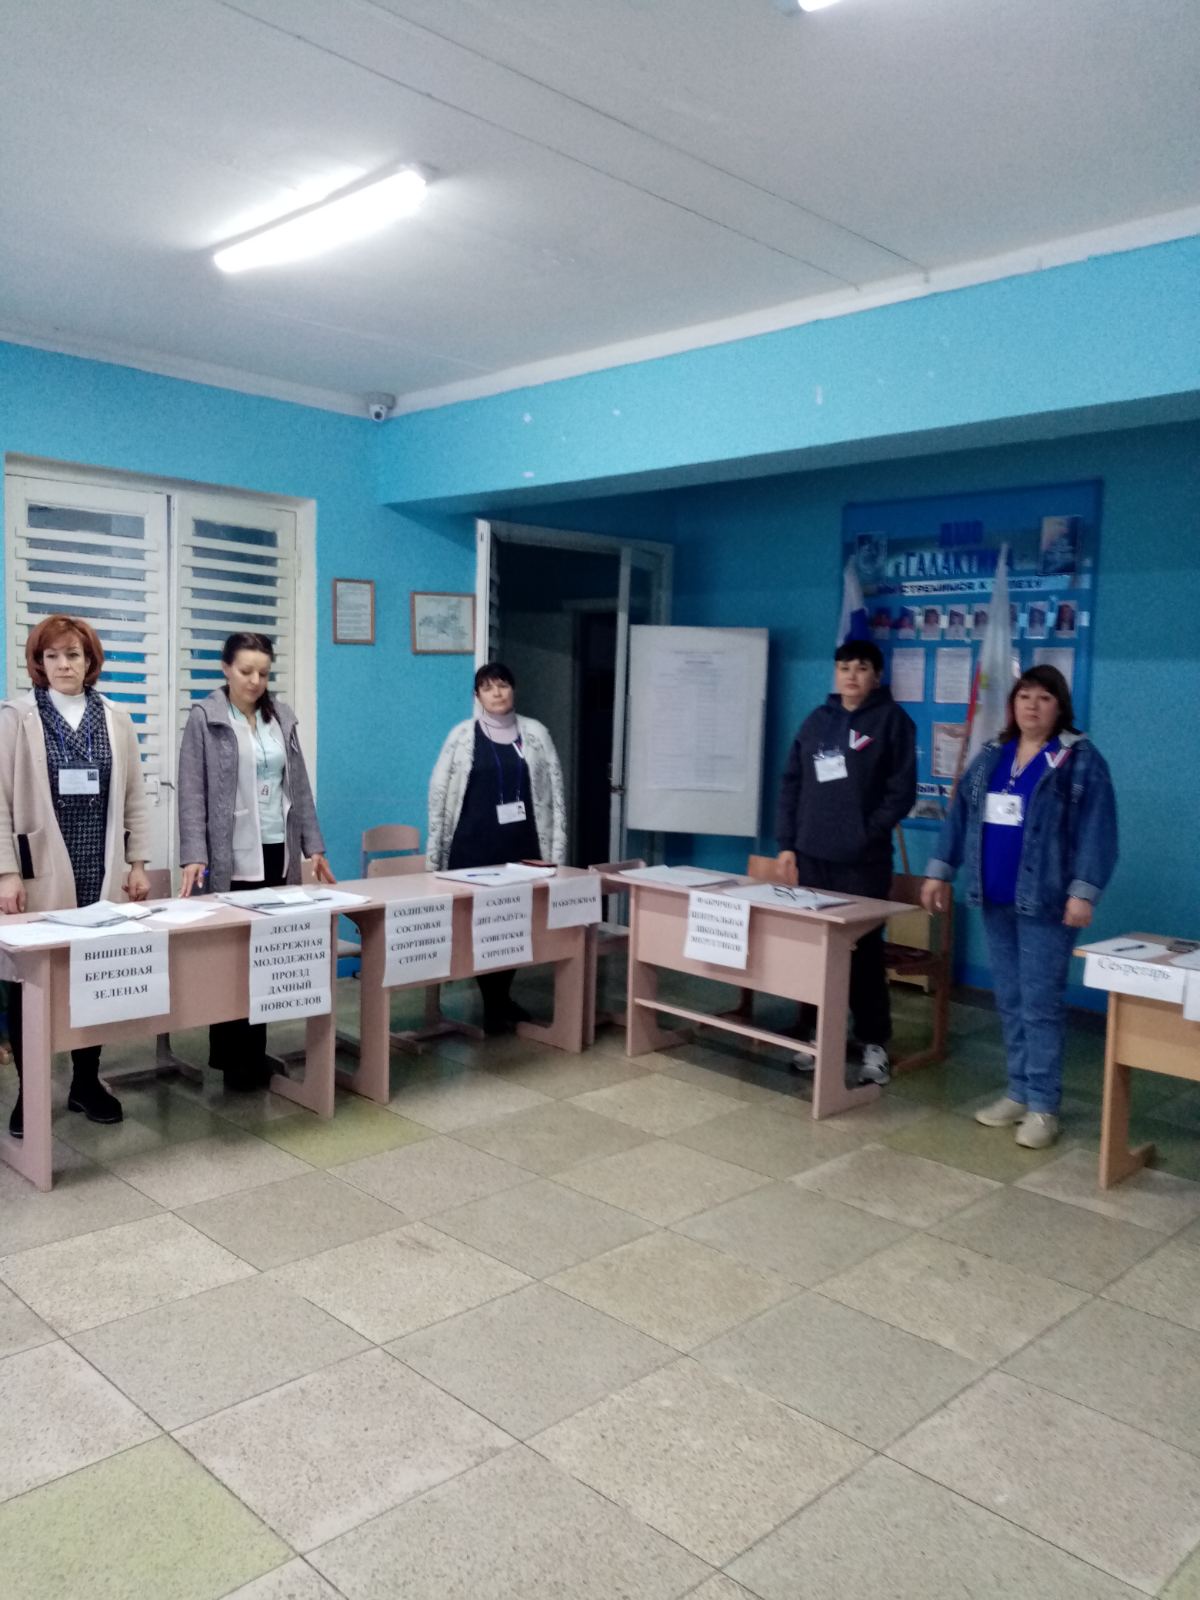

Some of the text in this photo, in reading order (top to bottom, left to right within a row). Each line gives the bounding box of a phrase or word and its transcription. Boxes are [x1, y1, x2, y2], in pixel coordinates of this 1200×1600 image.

[486, 895, 521, 908] САДОВАЯ
[393, 903, 445, 918] СОЛНЕЧНАЯ
[270, 922, 311, 935] ЛЕСНАЯ
[396, 920, 441, 934] СОСНОВАЯ
[391, 935, 446, 952] СПОРТИВНАЯ
[481, 931, 525, 944] СОВЕТСКАЯ
[84, 944, 153, 961] ВИШНЕВАЯ
[255, 938, 323, 954] НАБЕРЕЖНАЯ
[481, 945, 525, 960] СИРЕНЕВАЯ
[253, 951, 326, 968] МОЛОДЕЖНАЯ
[85, 965, 153, 982] БЕРЕЗОВАЯ
[271, 967, 310, 981] ПРОЕЗД
[93, 984, 148, 1000] ЗЕЛЕНАЯ
[268, 979, 312, 995] ДАЧНЫЙ
[260, 995, 322, 1012] НОВОСЕЛОВ
